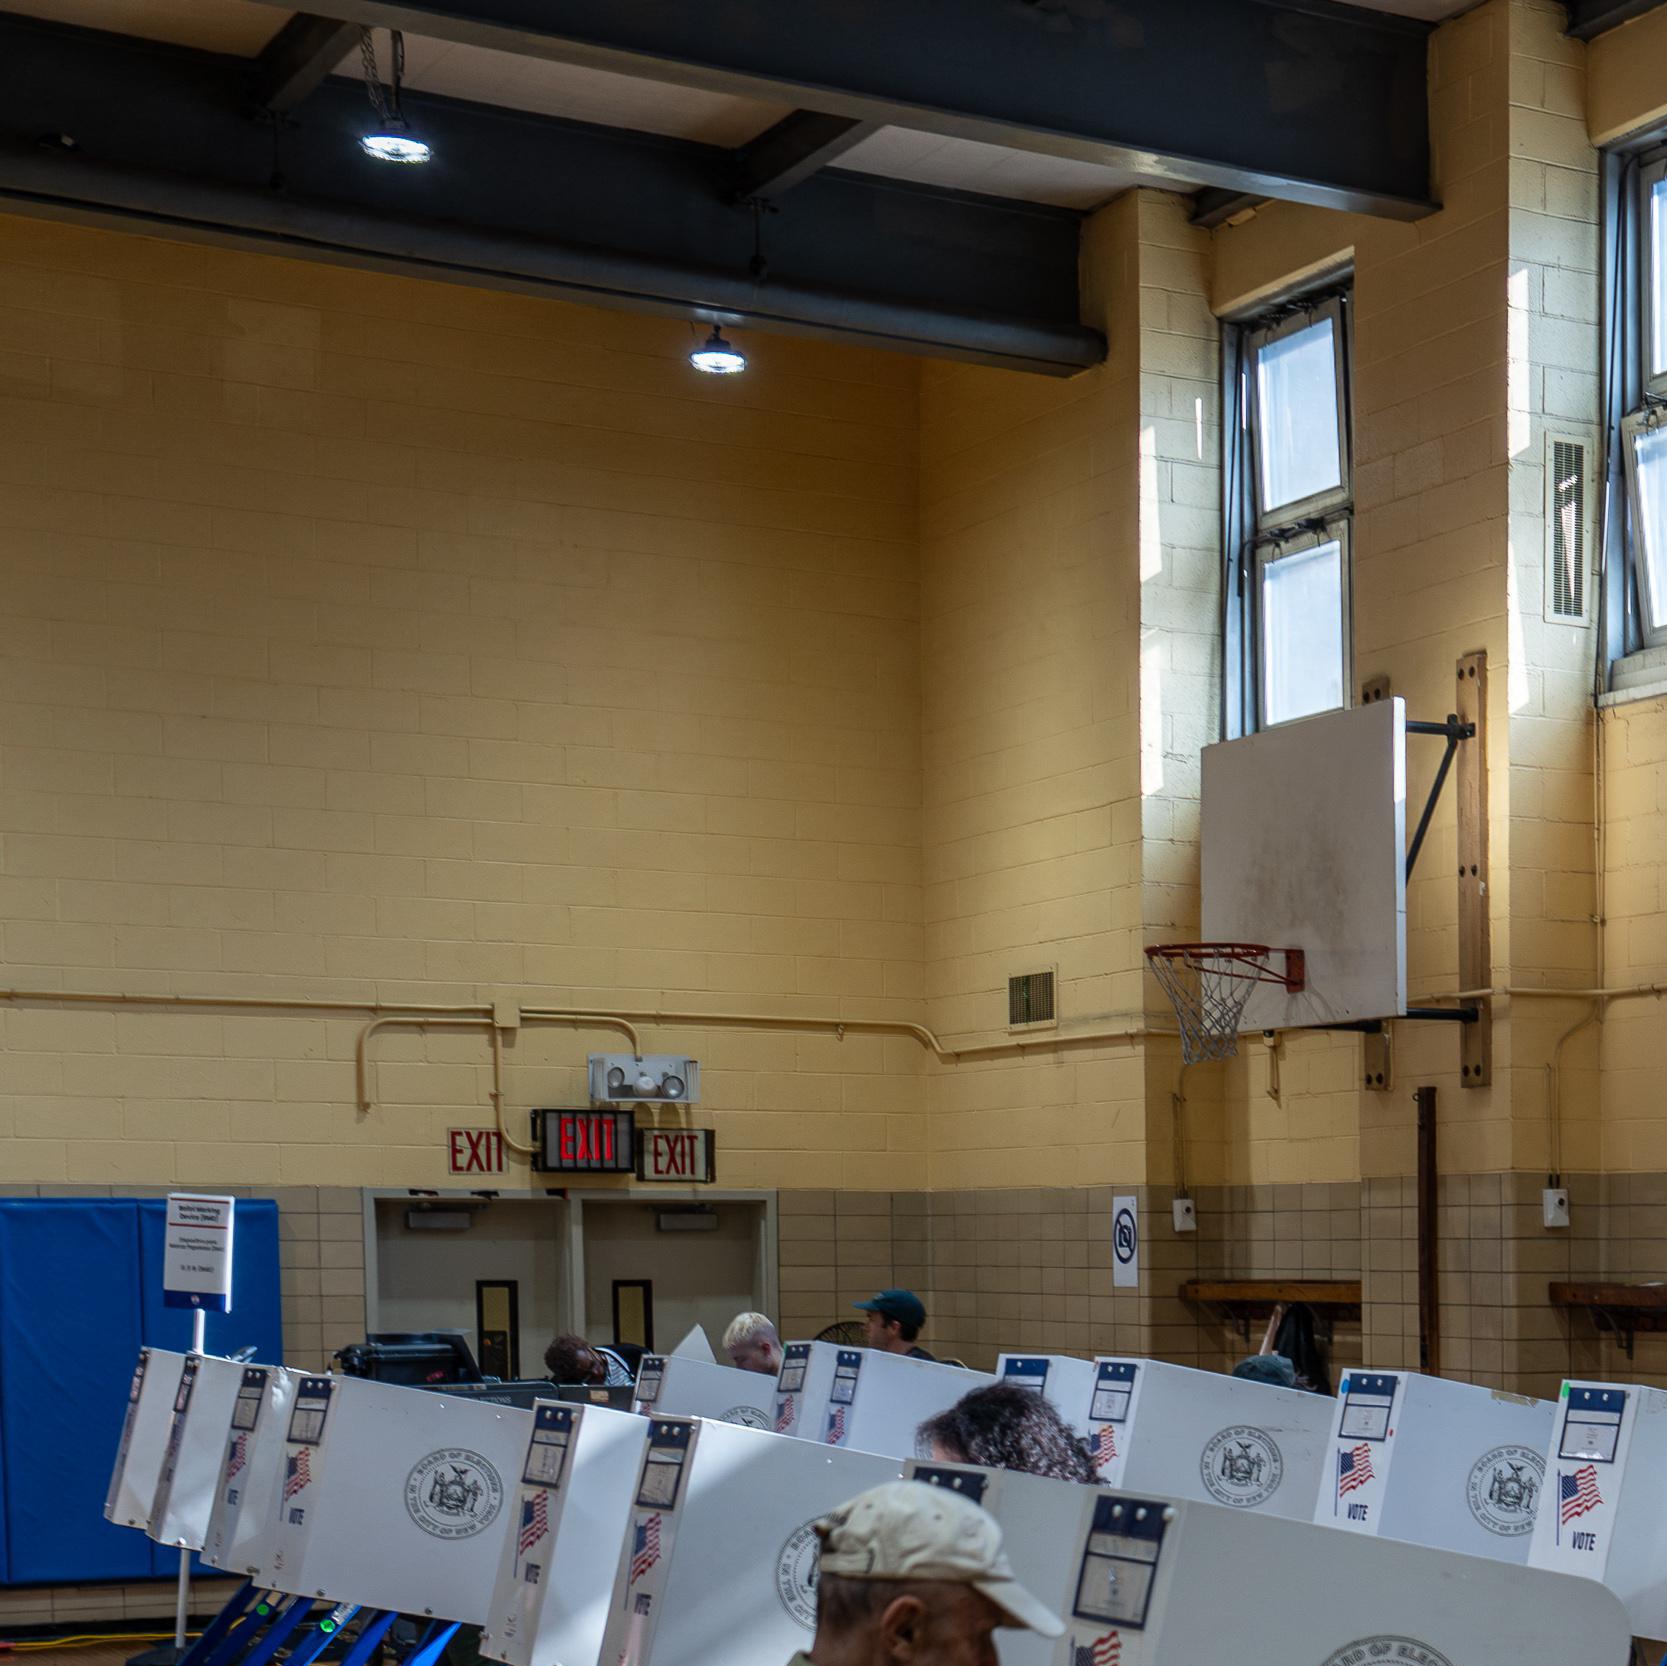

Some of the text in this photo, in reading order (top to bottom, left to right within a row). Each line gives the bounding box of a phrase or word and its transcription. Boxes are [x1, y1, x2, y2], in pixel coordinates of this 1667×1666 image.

[450, 1130, 504, 1173] EXIT
[559, 1117, 615, 1161] EXIT
[652, 1134, 699, 1175] EXIT
[1348, 1503, 1369, 1521] VOTE
[1572, 1530, 1597, 1551] VOTE
[1369, 1643, 1392, 1656] OF
